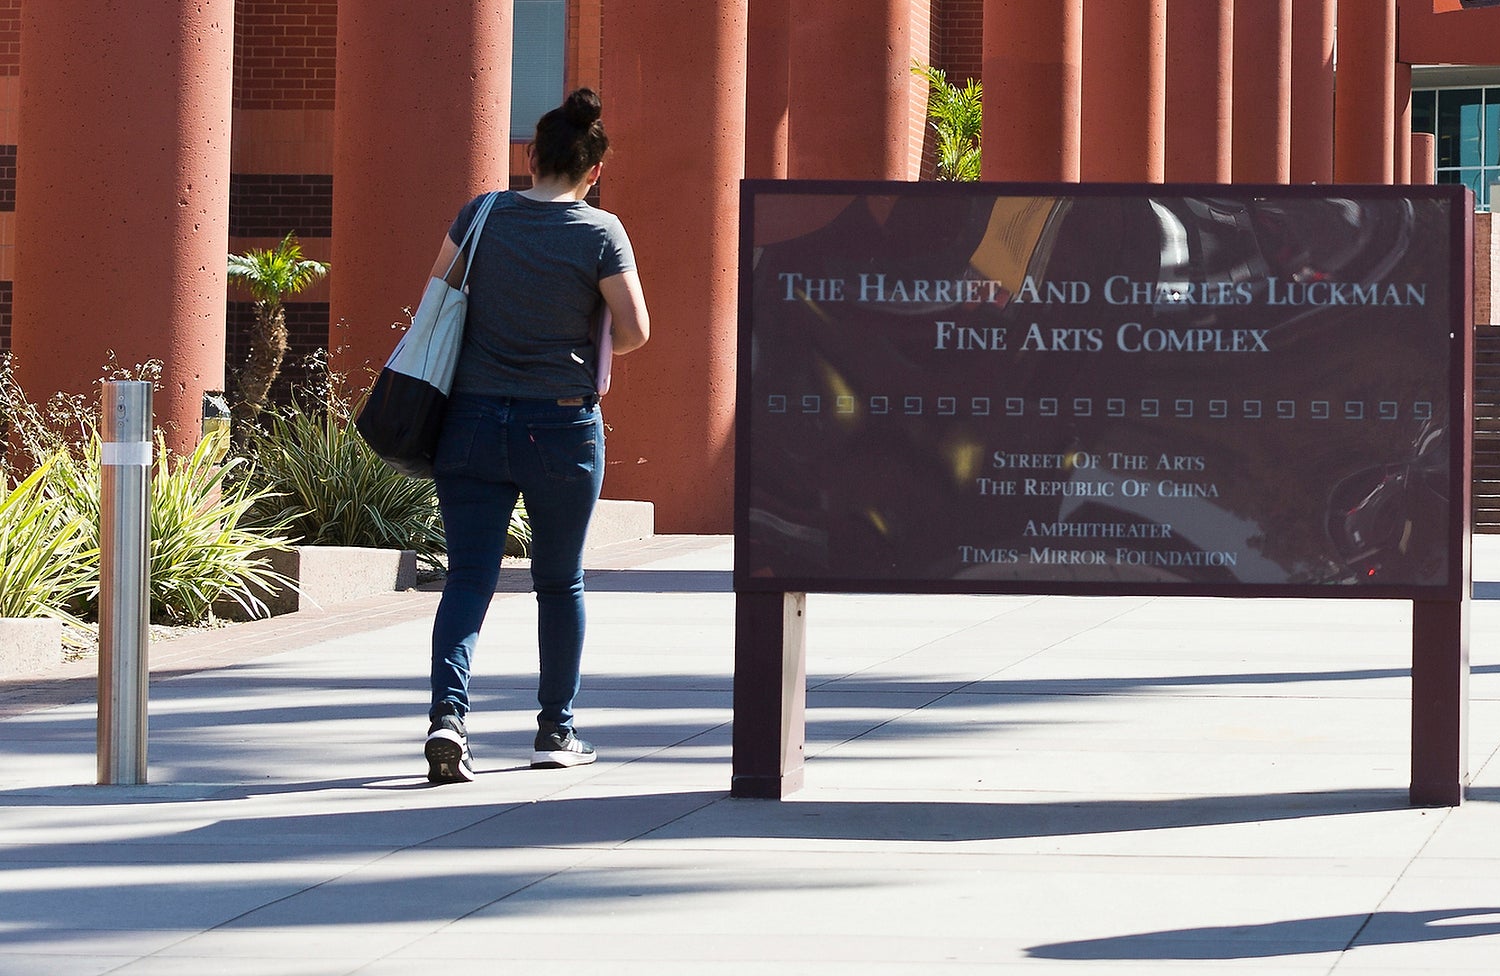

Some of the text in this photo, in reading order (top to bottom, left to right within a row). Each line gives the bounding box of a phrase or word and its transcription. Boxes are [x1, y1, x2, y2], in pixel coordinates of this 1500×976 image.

[778, 272, 1427, 307] THE HARRIET AND CHARLES LUCKMAN
[934, 320, 1271, 353] FINE ARTS COMPLEX
[992, 450, 1206, 472] STREET OF THE ARTS
[975, 477, 1220, 498] THE REPUBLIC OF CHINA
[1021, 518, 1173, 538] AMPHITHEATER
[958, 544, 1239, 567] TIMES-MIRROR FOUNDATION
